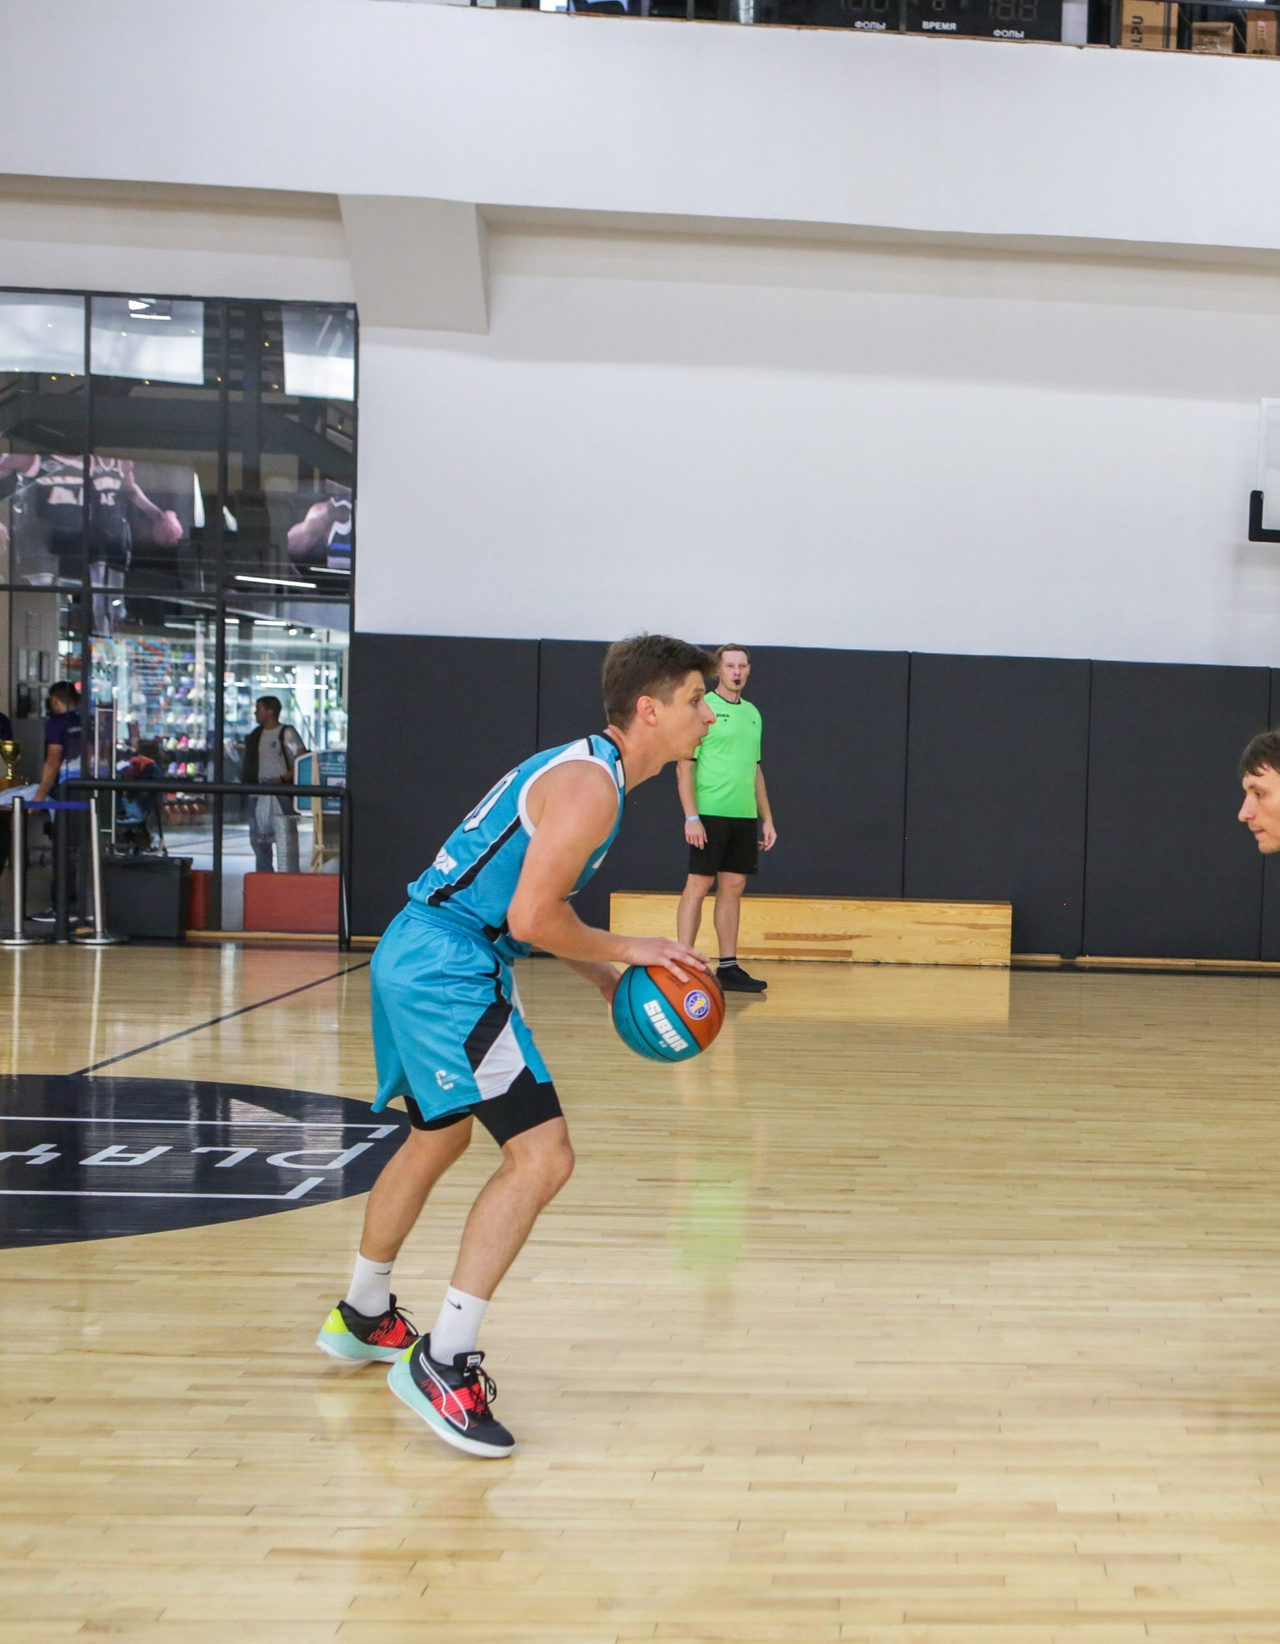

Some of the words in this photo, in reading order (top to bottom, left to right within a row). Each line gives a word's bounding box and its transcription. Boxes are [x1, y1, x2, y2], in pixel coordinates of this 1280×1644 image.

[854, 20, 887, 31] ФОЛЫ
[922, 20, 957, 32] ВРЕМЯ
[993, 29, 1025, 39] ФОЛЫ
[643, 999, 689, 1053] SIBUR
